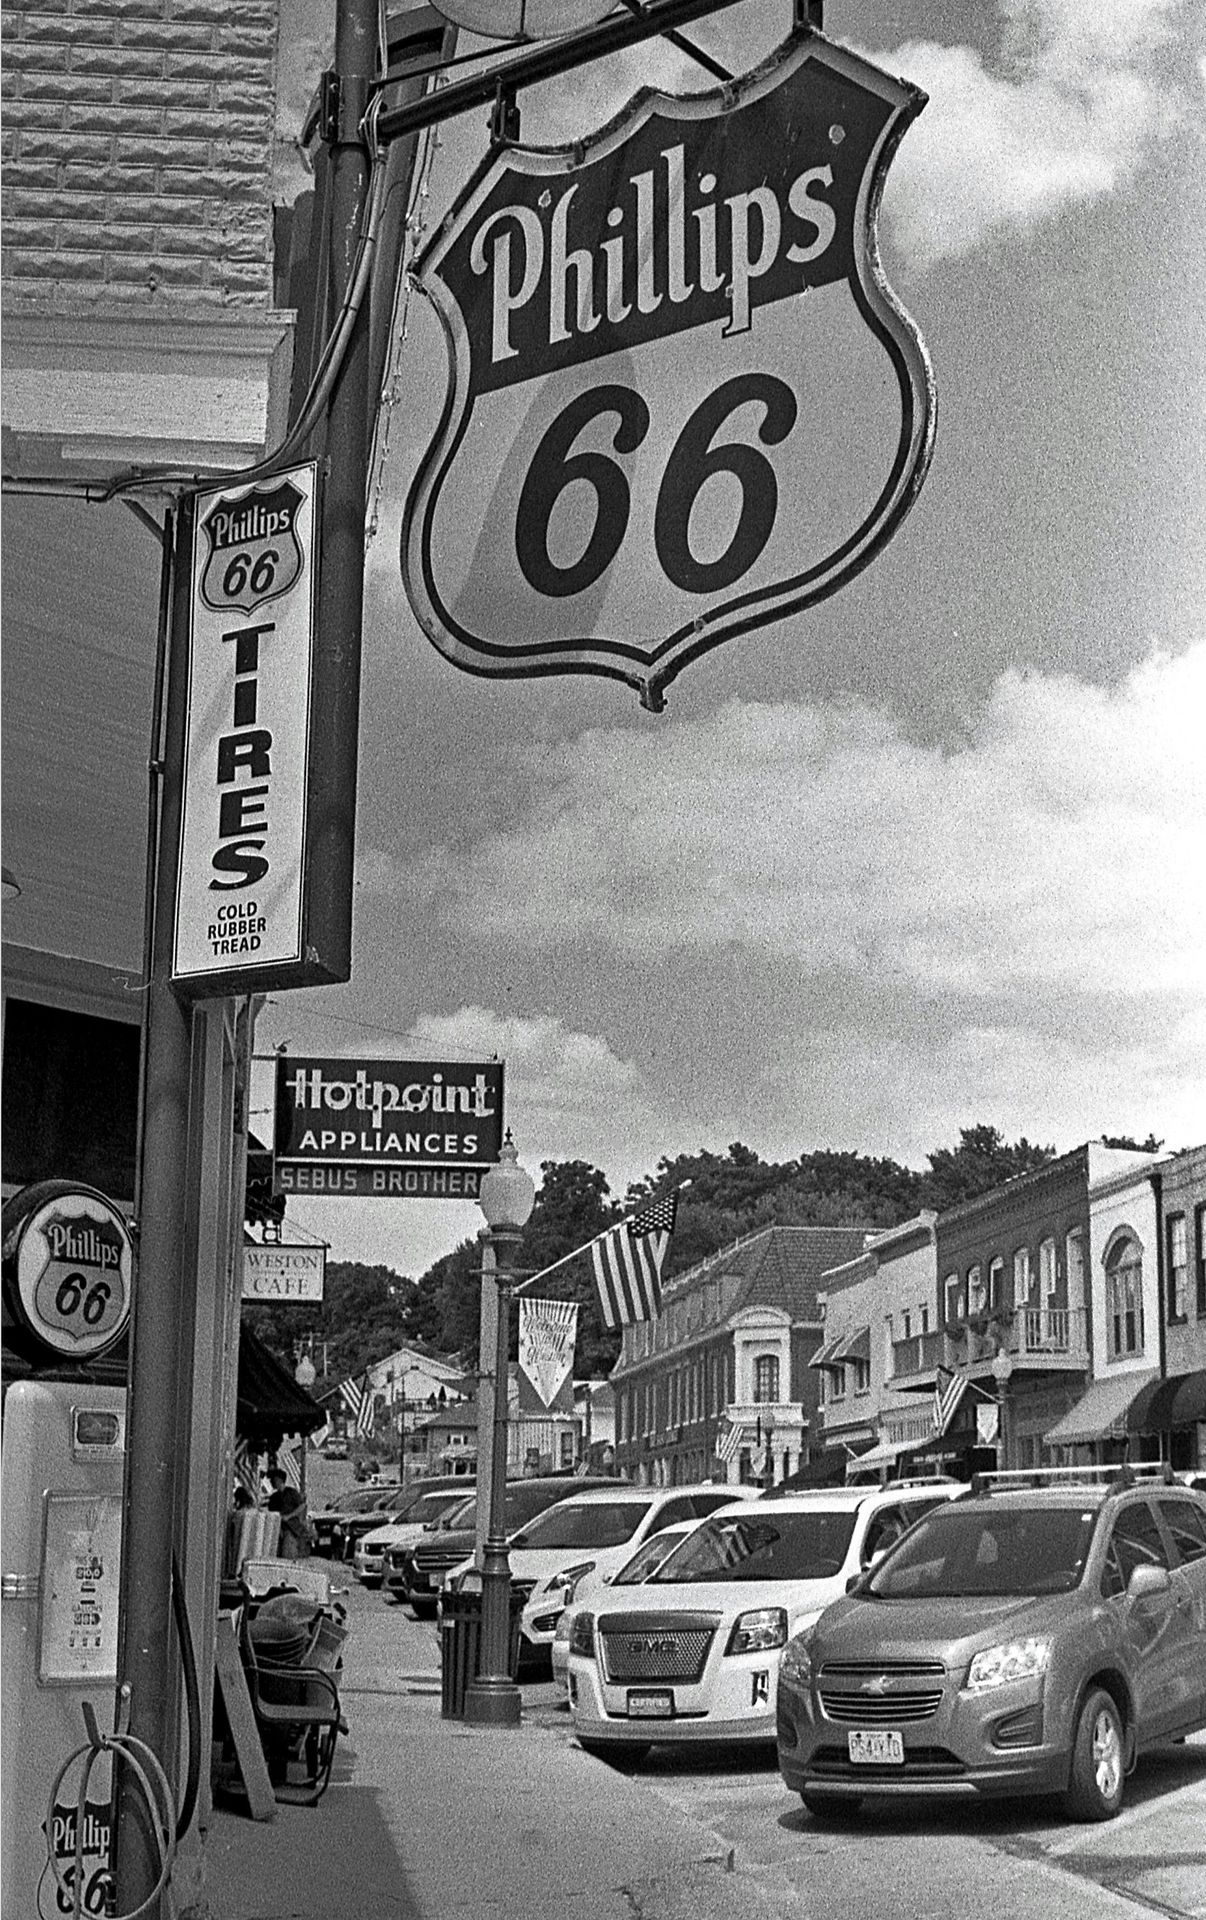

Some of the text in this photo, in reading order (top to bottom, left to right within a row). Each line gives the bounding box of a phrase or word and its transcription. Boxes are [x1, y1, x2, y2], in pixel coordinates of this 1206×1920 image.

[470, 144, 836, 363] Phillips
[515, 373, 798, 598] 66
[210, 505, 290, 547] Phillips
[223, 550, 280, 597] 66
[208, 622, 275, 890] TIRES
[207, 917, 266, 940] RUBBER
[217, 901, 257, 921] COLD
[212, 935, 261, 956] TREAD
[285, 1069, 496, 1128] Hotpoint
[300, 1130, 478, 1154] APPLIANCES
[281, 1168, 478, 1193] SEBUS BROTHER
[48, 1223, 119, 1272] Phillips
[248, 1254, 318, 1268] WESTON
[55, 1272, 111, 1325] 66
[252, 1278, 309, 1294] CAFE
[52, 1815, 110, 1858] Phllip
